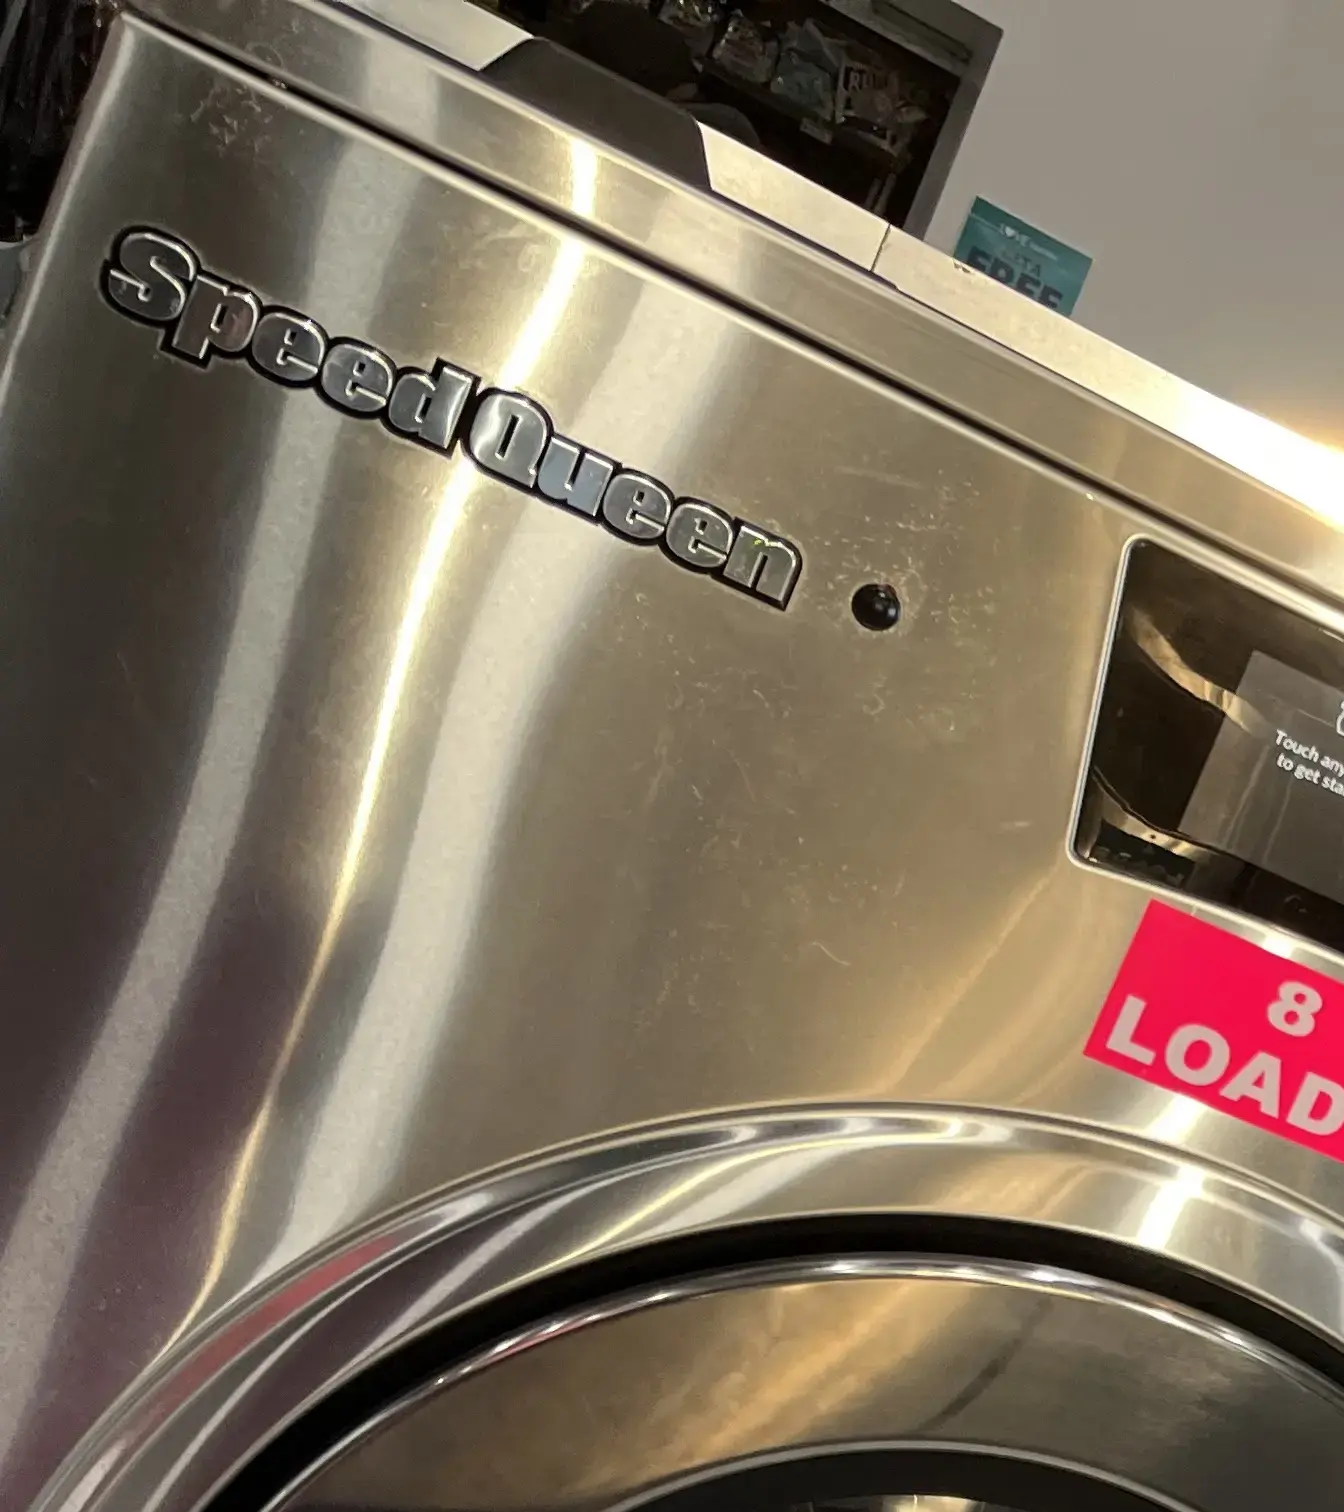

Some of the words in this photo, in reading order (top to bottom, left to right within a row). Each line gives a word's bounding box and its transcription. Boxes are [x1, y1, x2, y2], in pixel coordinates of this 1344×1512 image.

[1275, 728, 1320, 763] Touch
[1277, 752, 1294, 771] to
[1293, 763, 1321, 784] get
[1266, 980, 1323, 1037] 8
